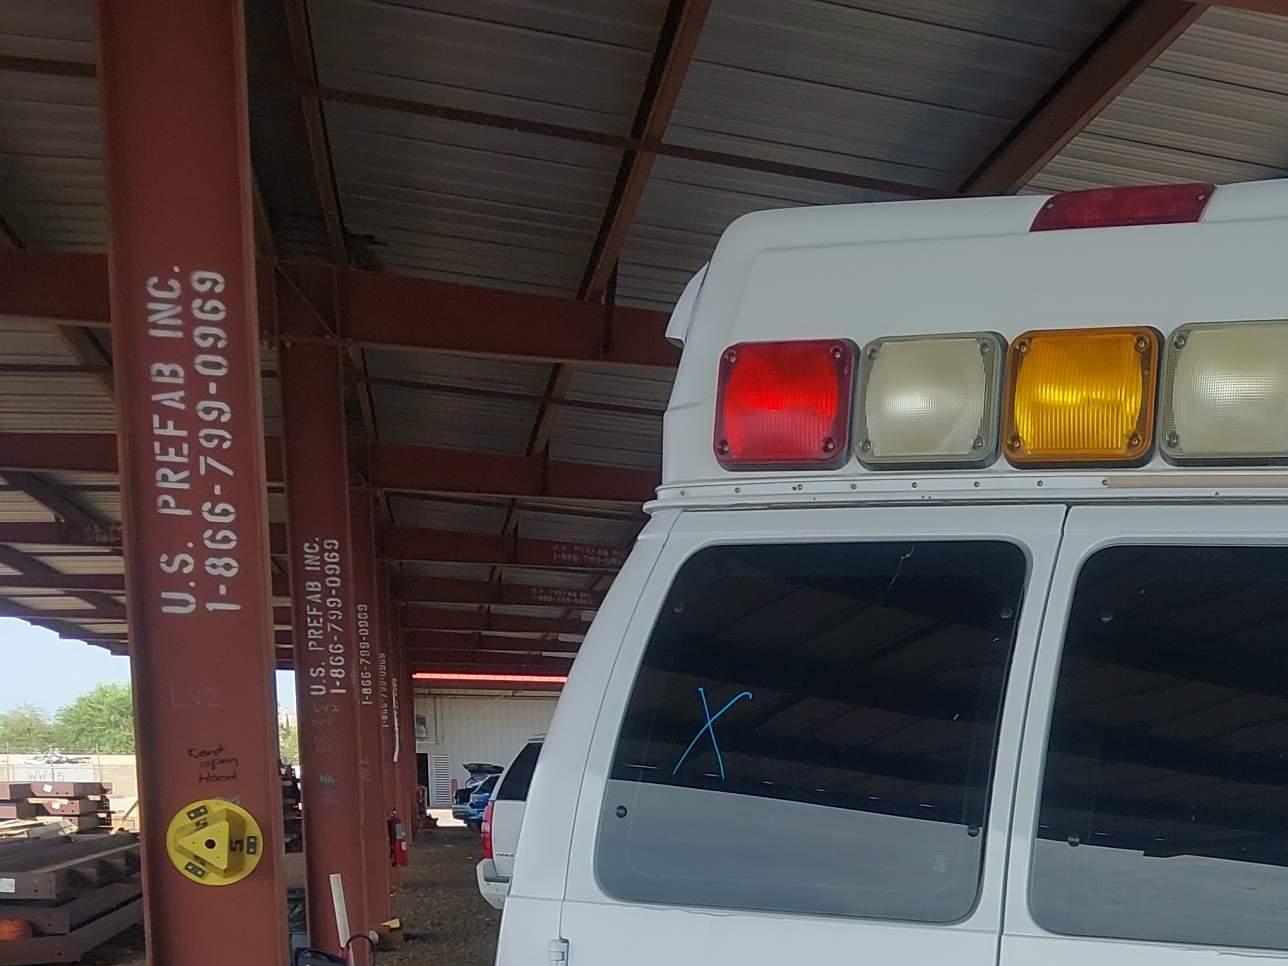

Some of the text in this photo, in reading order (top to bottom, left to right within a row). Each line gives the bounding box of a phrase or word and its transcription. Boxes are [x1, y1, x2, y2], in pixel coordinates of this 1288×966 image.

[146, 265, 197, 614] U.S. PREFAB INC.
[190, 270, 242, 612] 1-866-799-0969
[303, 537, 326, 696] U.S. PREFAB INC.
[323, 539, 347, 694] 1-866-799-0969
